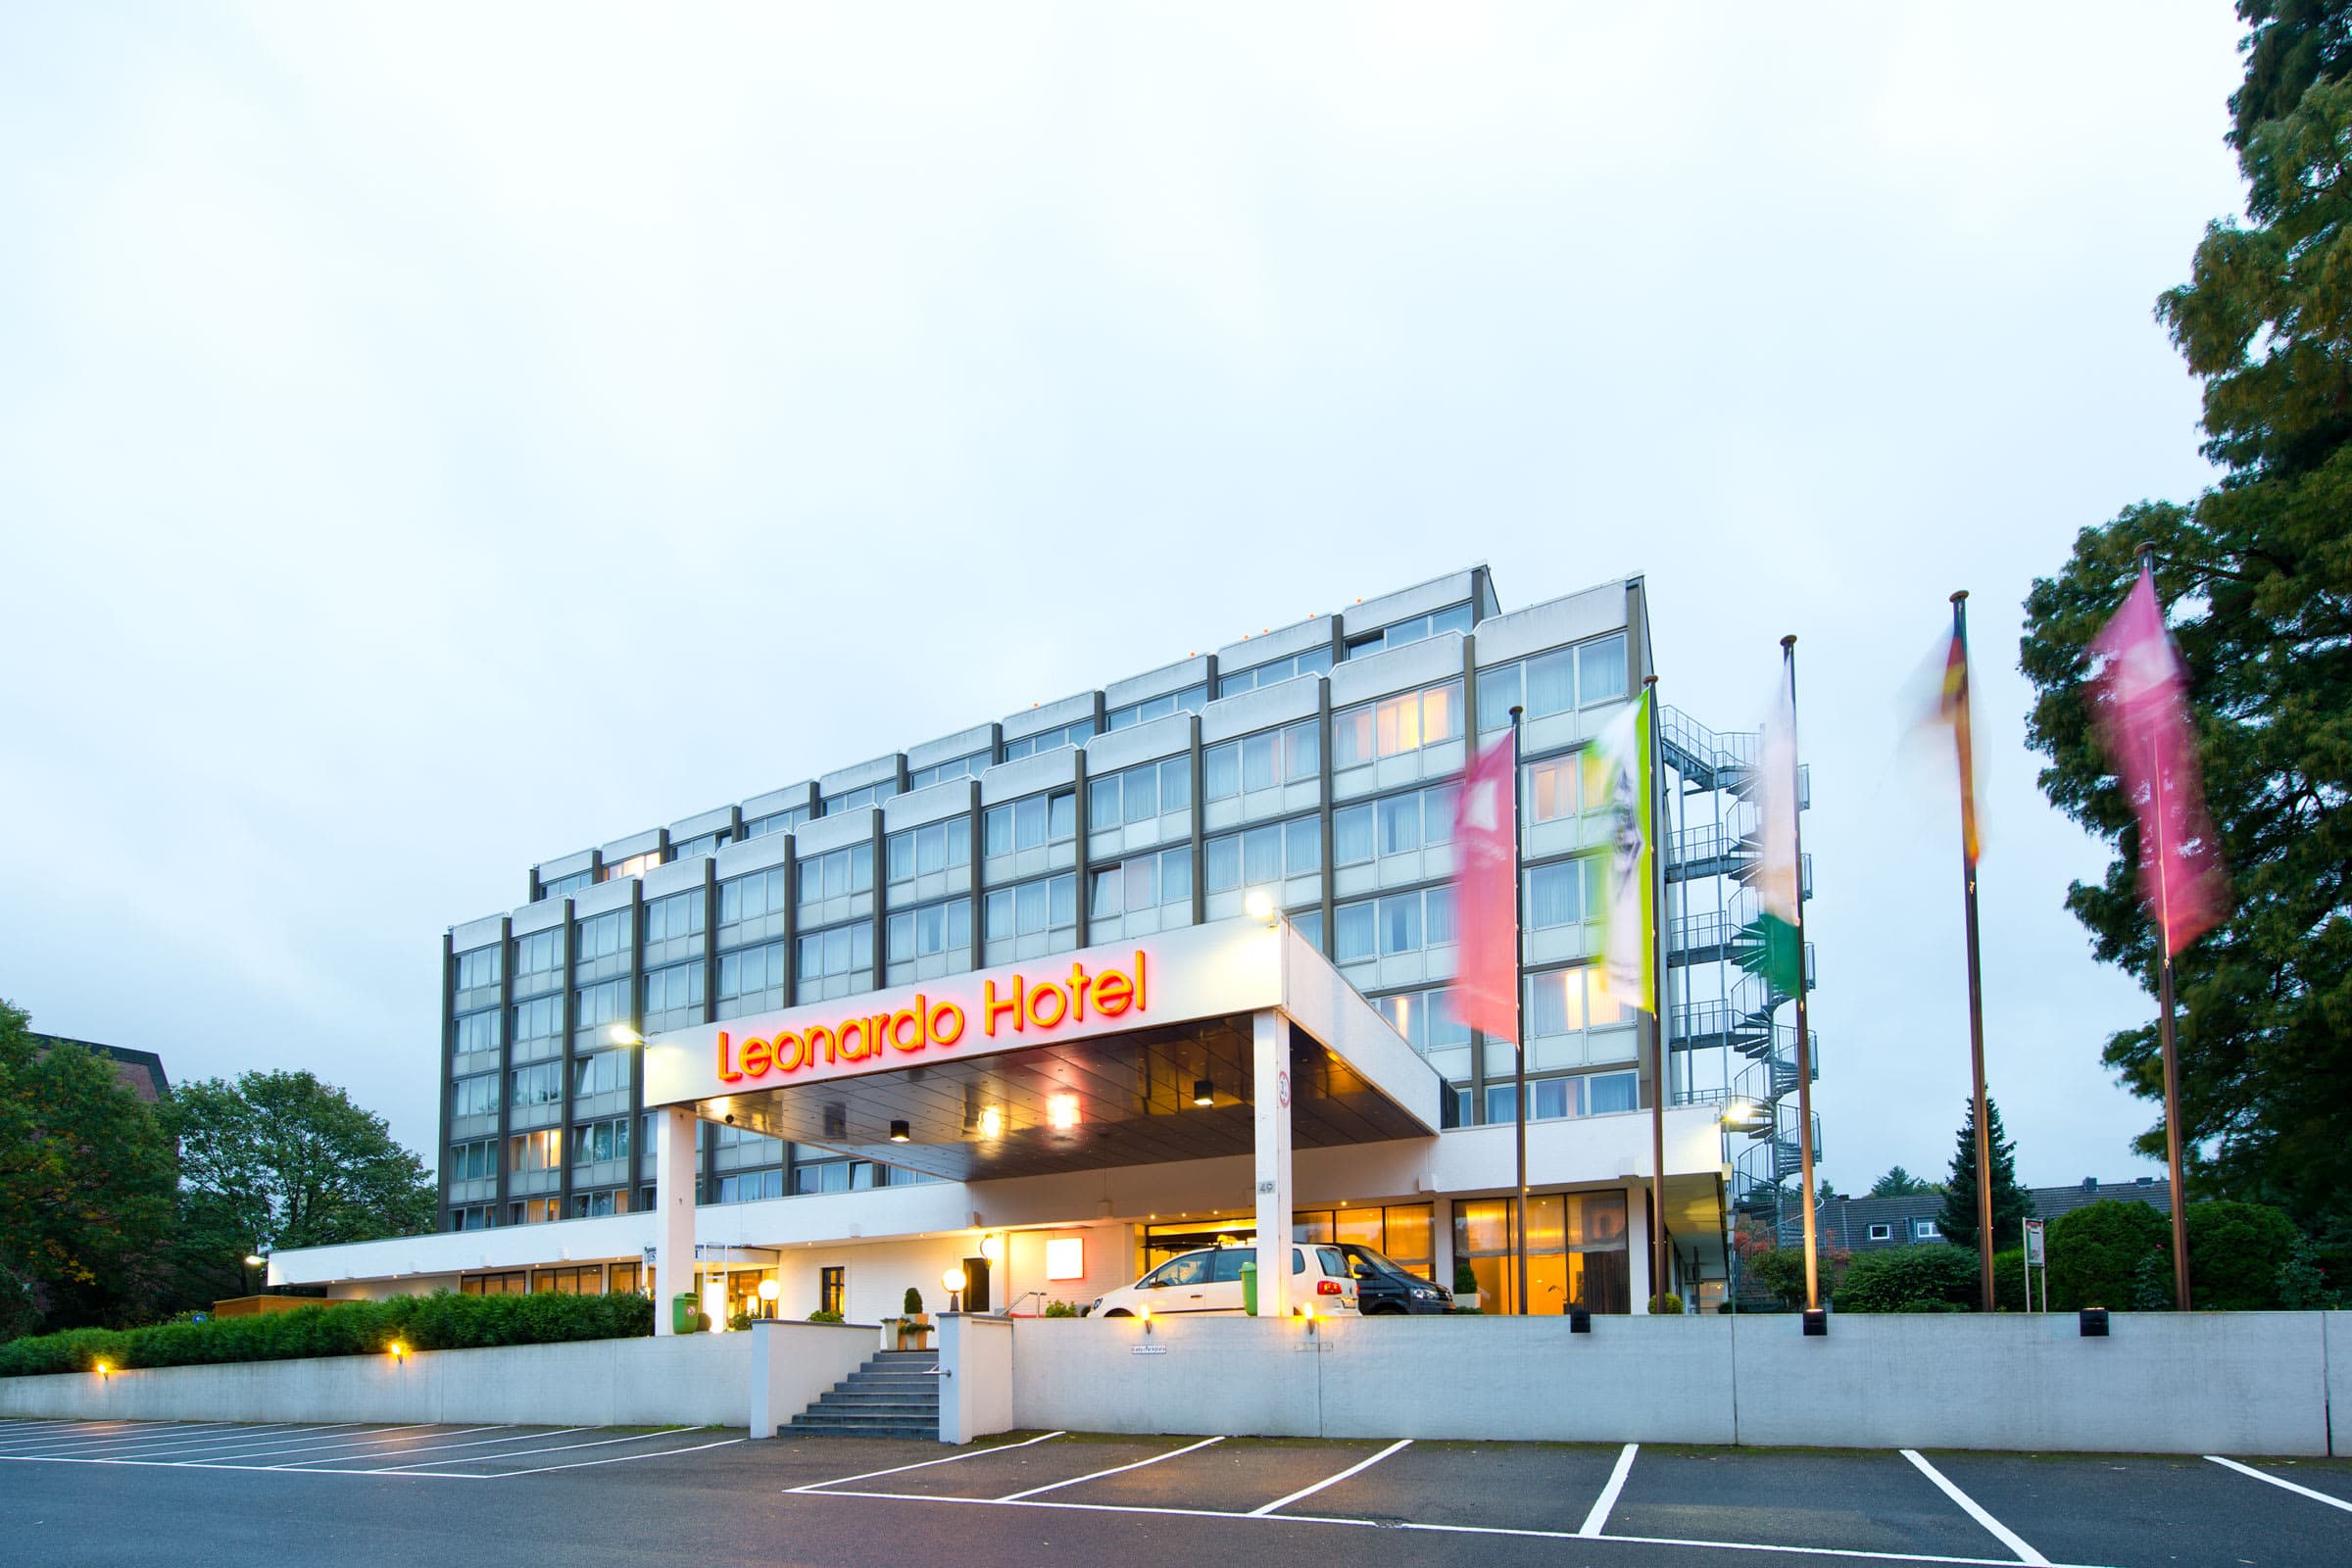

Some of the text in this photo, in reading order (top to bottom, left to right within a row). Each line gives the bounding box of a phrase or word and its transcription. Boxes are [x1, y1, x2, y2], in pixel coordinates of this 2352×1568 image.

[717, 950, 1147, 1082] Leonardo Hotel
[1259, 1183, 1274, 1194] 49
